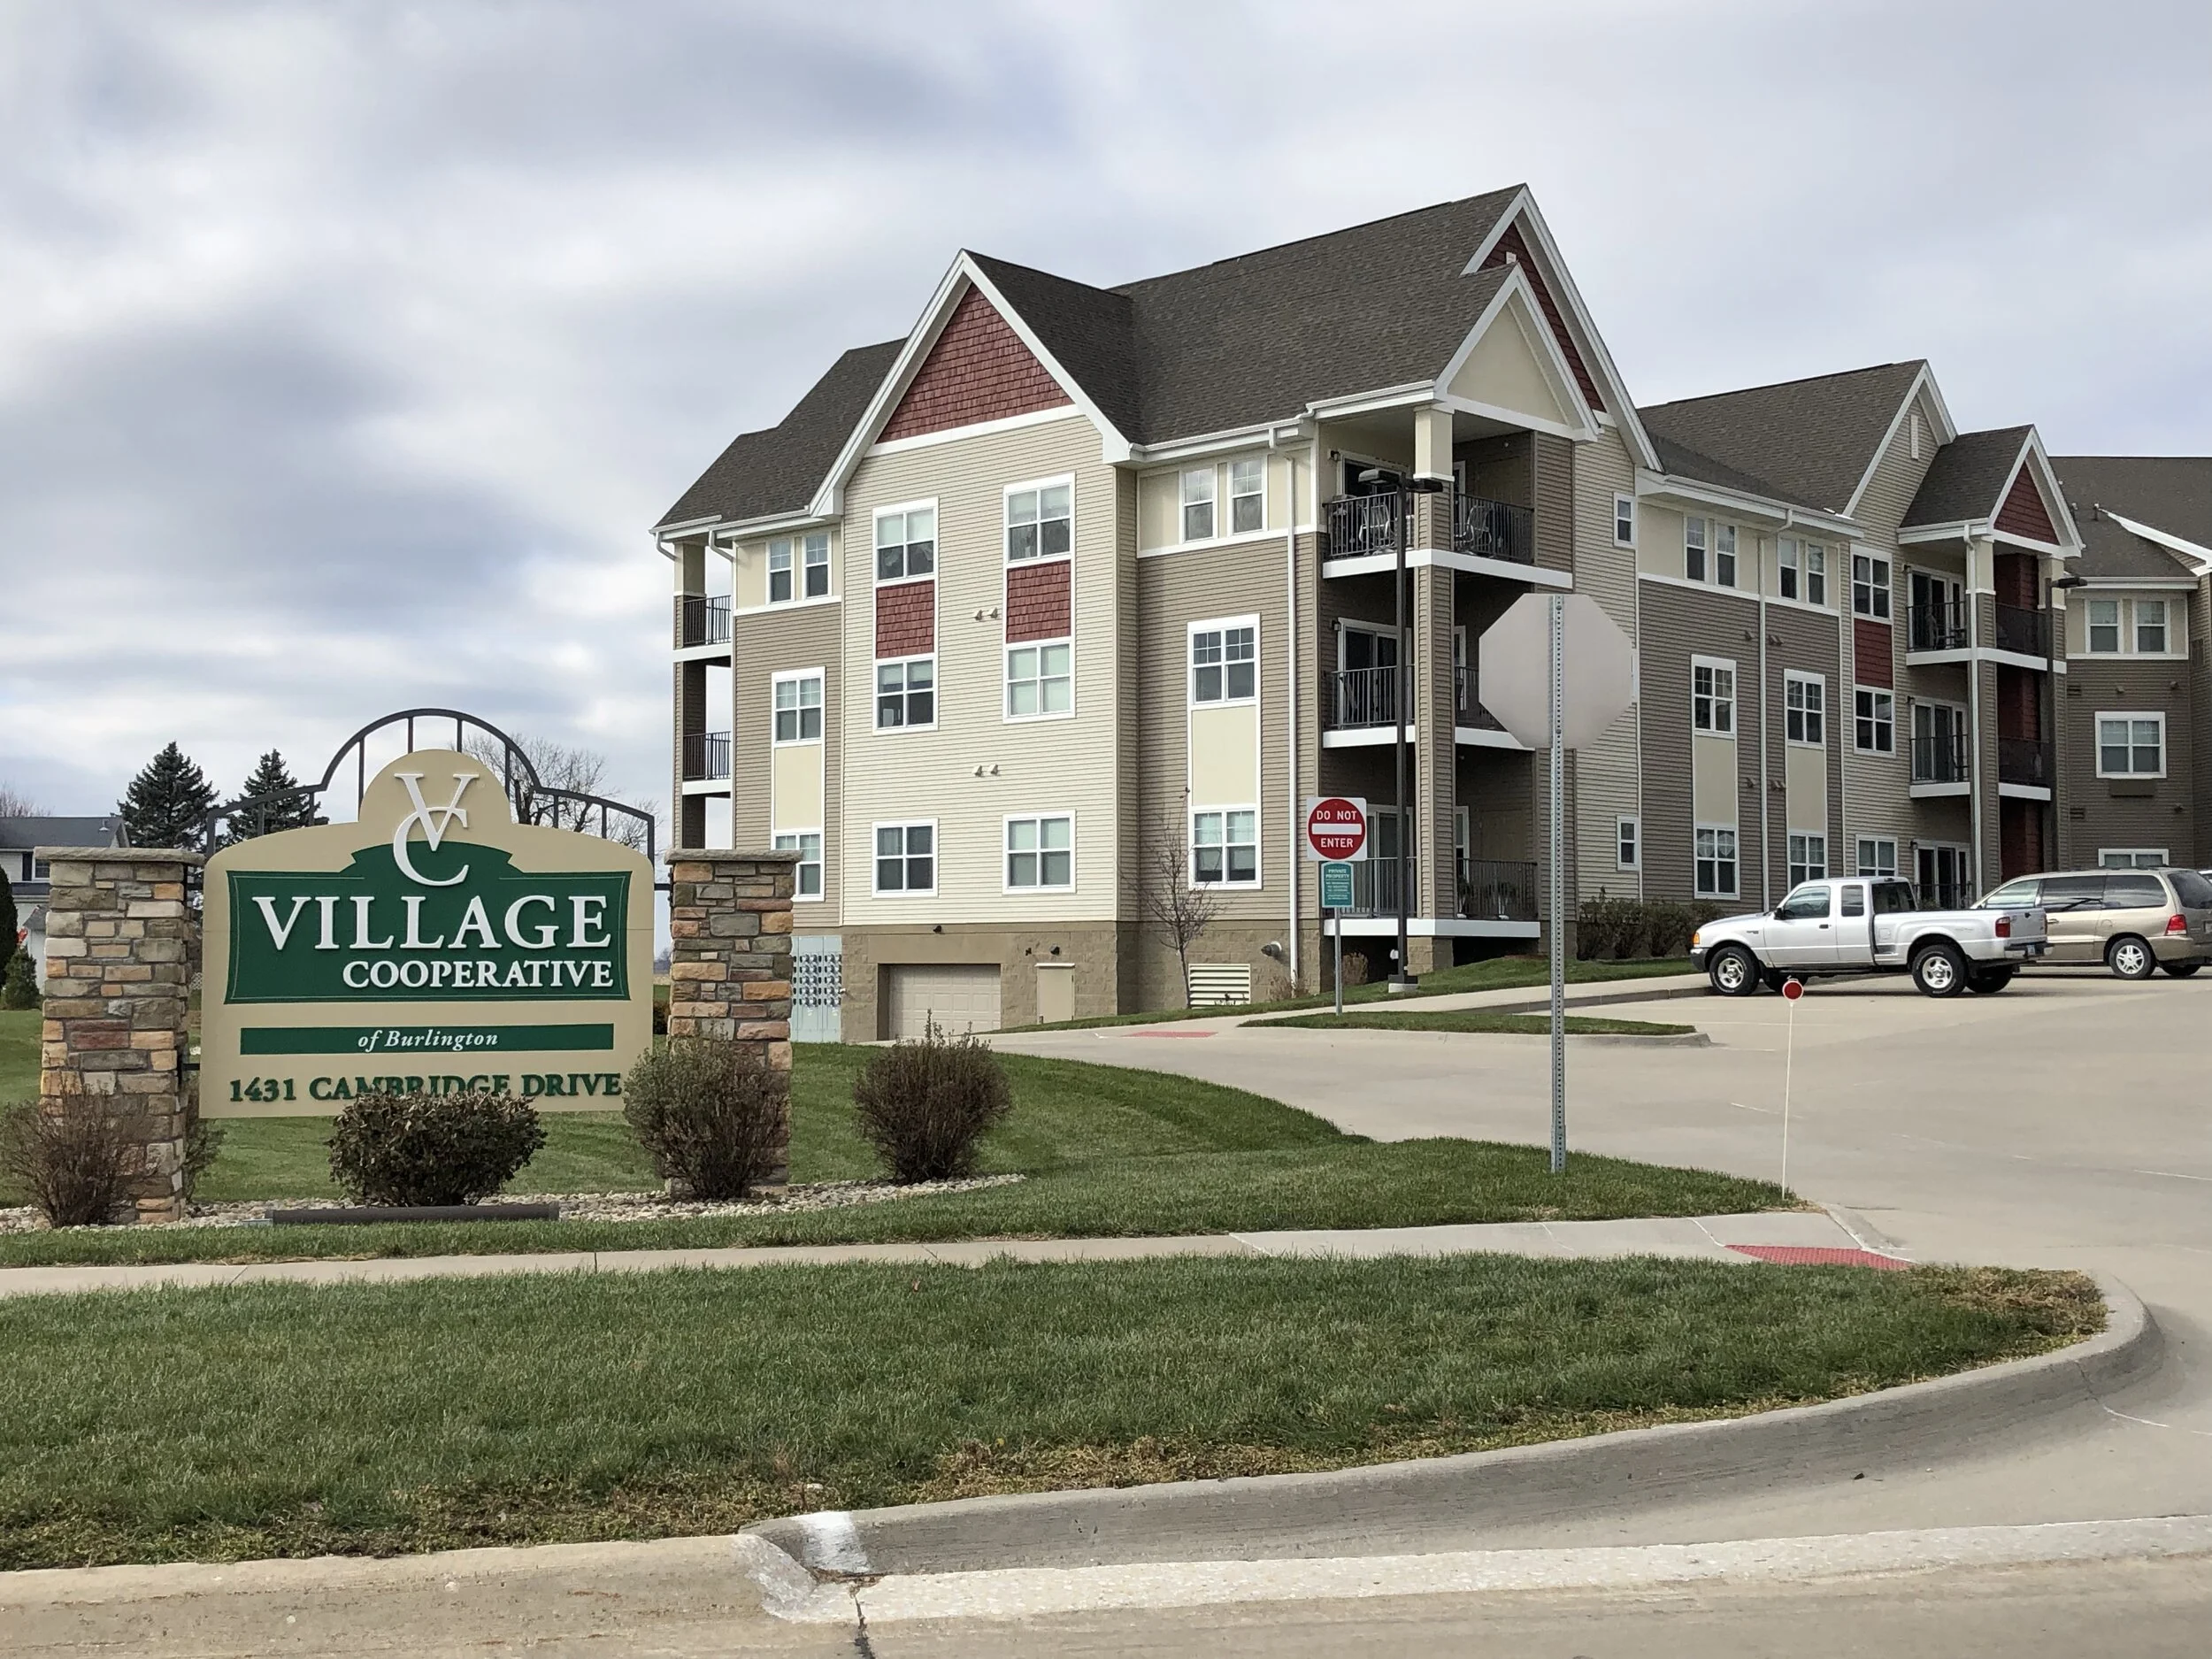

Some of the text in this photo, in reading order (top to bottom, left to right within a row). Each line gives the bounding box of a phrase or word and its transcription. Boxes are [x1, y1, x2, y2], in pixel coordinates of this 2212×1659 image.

[1317, 810, 1356, 820] DO NOT
[1320, 838, 1354, 848] ENTER
[251, 895, 611, 950] VILLAGE
[342, 959, 614, 989] COOPERATIVE
[358, 1028, 498, 1052] of Burlington
[230, 1077, 296, 1102] 1431
[521, 1072, 622, 1096] DRIVE
